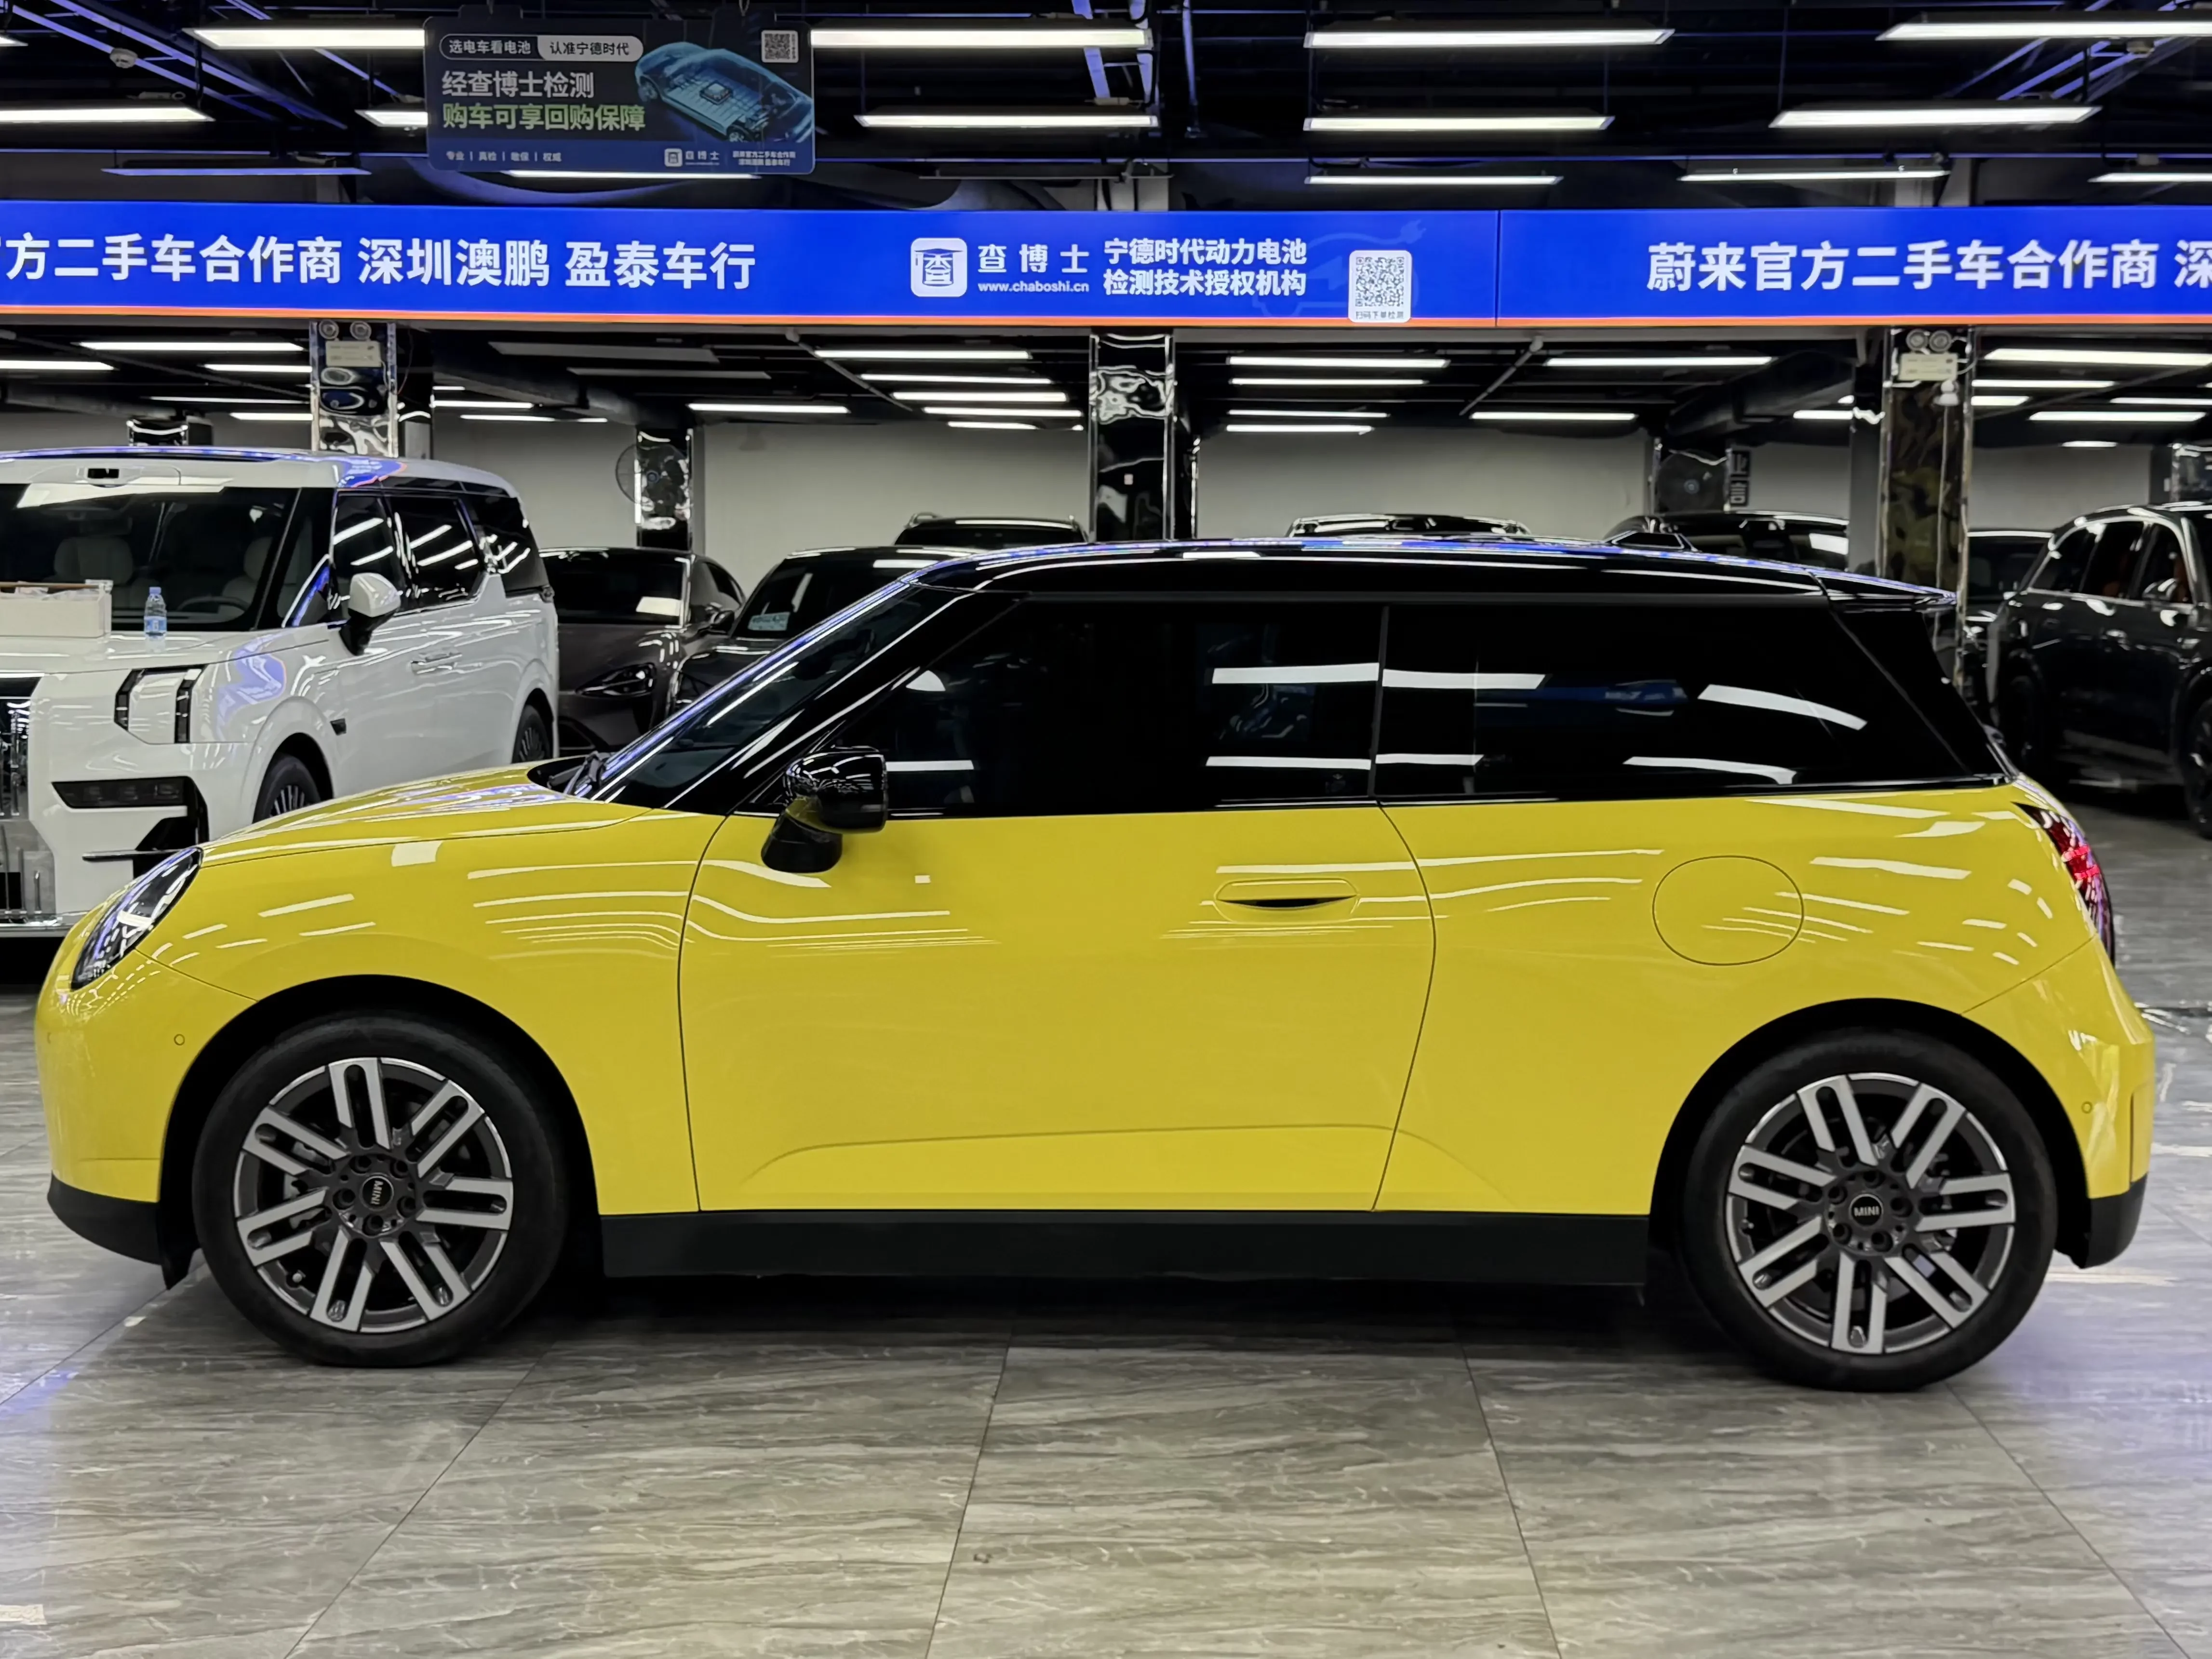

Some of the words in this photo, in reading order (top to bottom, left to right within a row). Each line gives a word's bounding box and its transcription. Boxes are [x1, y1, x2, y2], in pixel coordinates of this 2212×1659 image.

[449, 40, 531, 55] 选电车看电池
[550, 41, 630, 56] 认准宁德时代
[441, 70, 595, 99] 经查博士检测
[442, 103, 646, 132] 购车可享回购保障
[0, 232, 342, 283] 方二手车合作商
[358, 237, 550, 286] 深圳澳鹏
[564, 240, 755, 290] 盈泰车行
[978, 243, 1089, 273] 查博士
[1104, 237, 1307, 265] 宁德时代动力电池
[1647, 239, 2160, 292] 蔚来官方二手车合作商
[2174, 240, 2212, 289] 深
[978, 281, 1090, 292] www.chaboshi.cn
[1103, 268, 1307, 296] 检测技术授权机构
[371, 1180, 383, 1205] MINI
[1854, 1206, 1880, 1217] MINI
